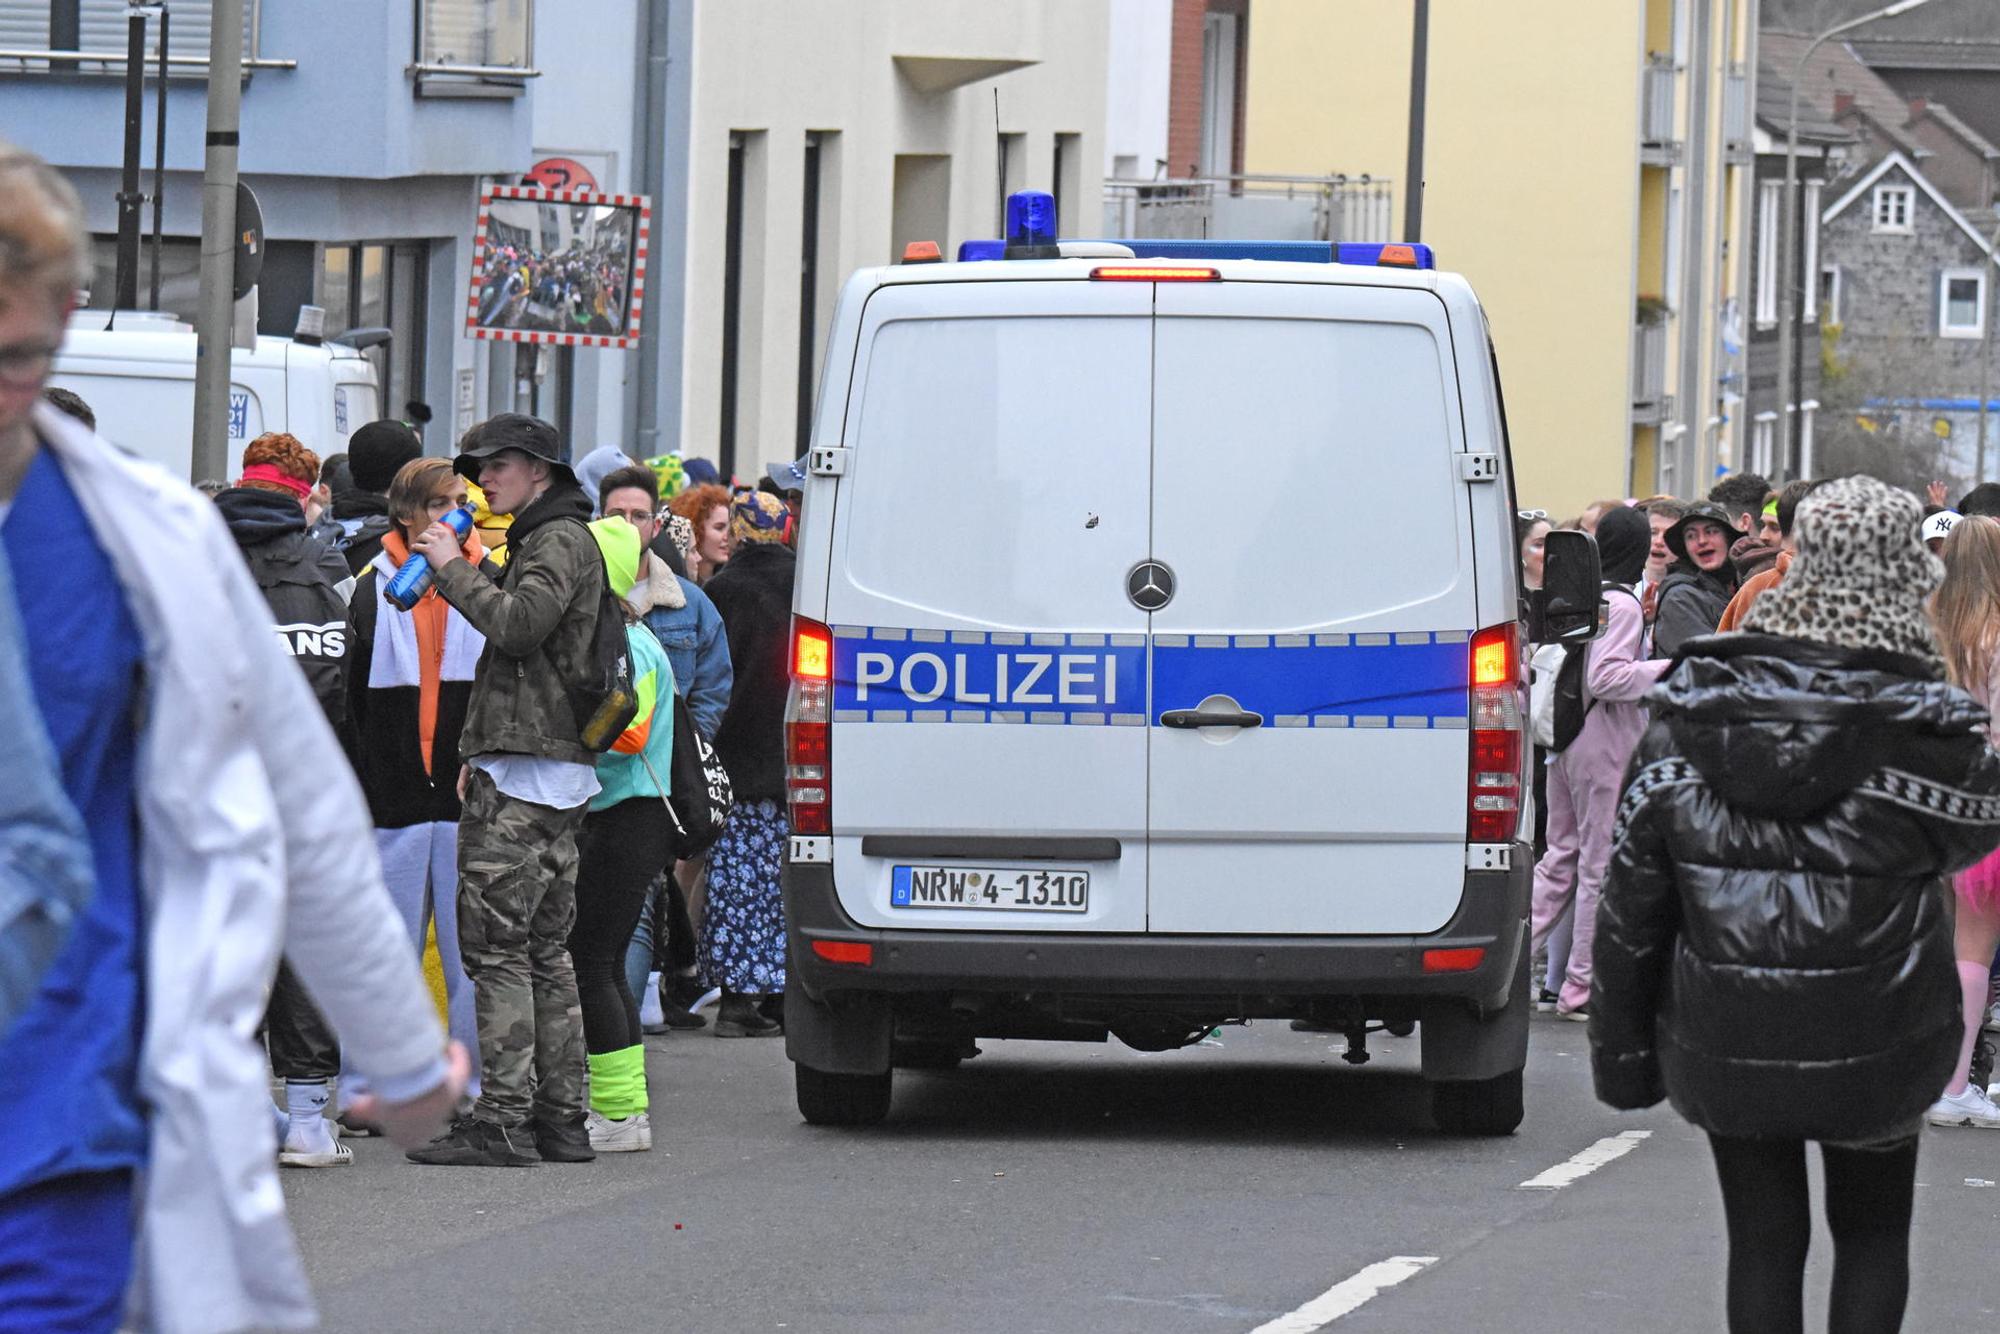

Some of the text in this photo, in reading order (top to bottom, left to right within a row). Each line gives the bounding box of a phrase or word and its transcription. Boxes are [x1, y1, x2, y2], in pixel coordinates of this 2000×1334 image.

[1935, 517, 1952, 532] NY
[274, 624, 345, 657] ANS
[856, 652, 1117, 704] POLIZEI
[898, 871, 1086, 906] D NRW 4-1310
